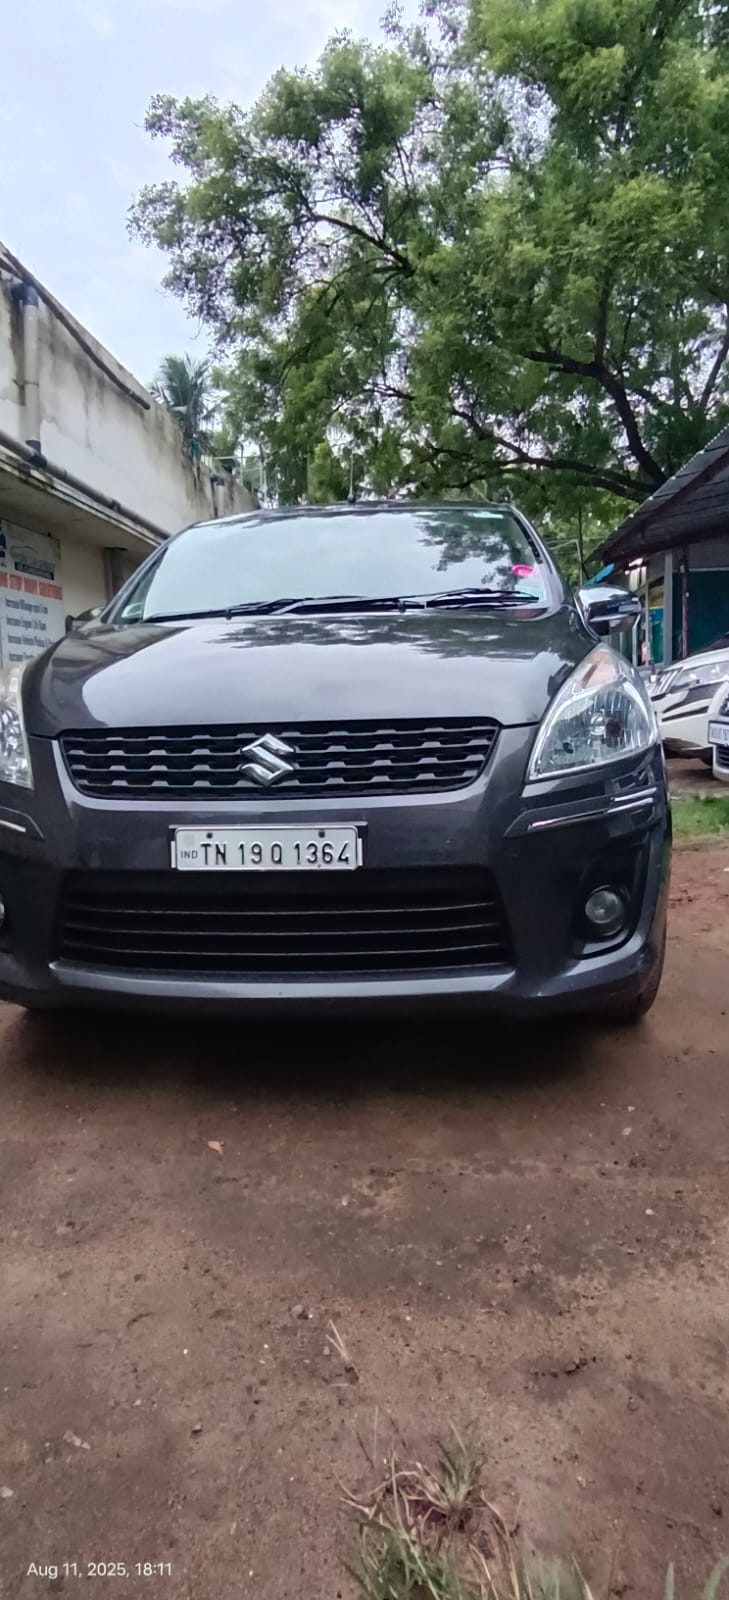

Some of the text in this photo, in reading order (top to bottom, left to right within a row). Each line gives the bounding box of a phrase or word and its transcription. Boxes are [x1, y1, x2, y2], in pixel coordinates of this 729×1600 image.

[180, 842, 350, 865] IND TN 19 Q 1364
